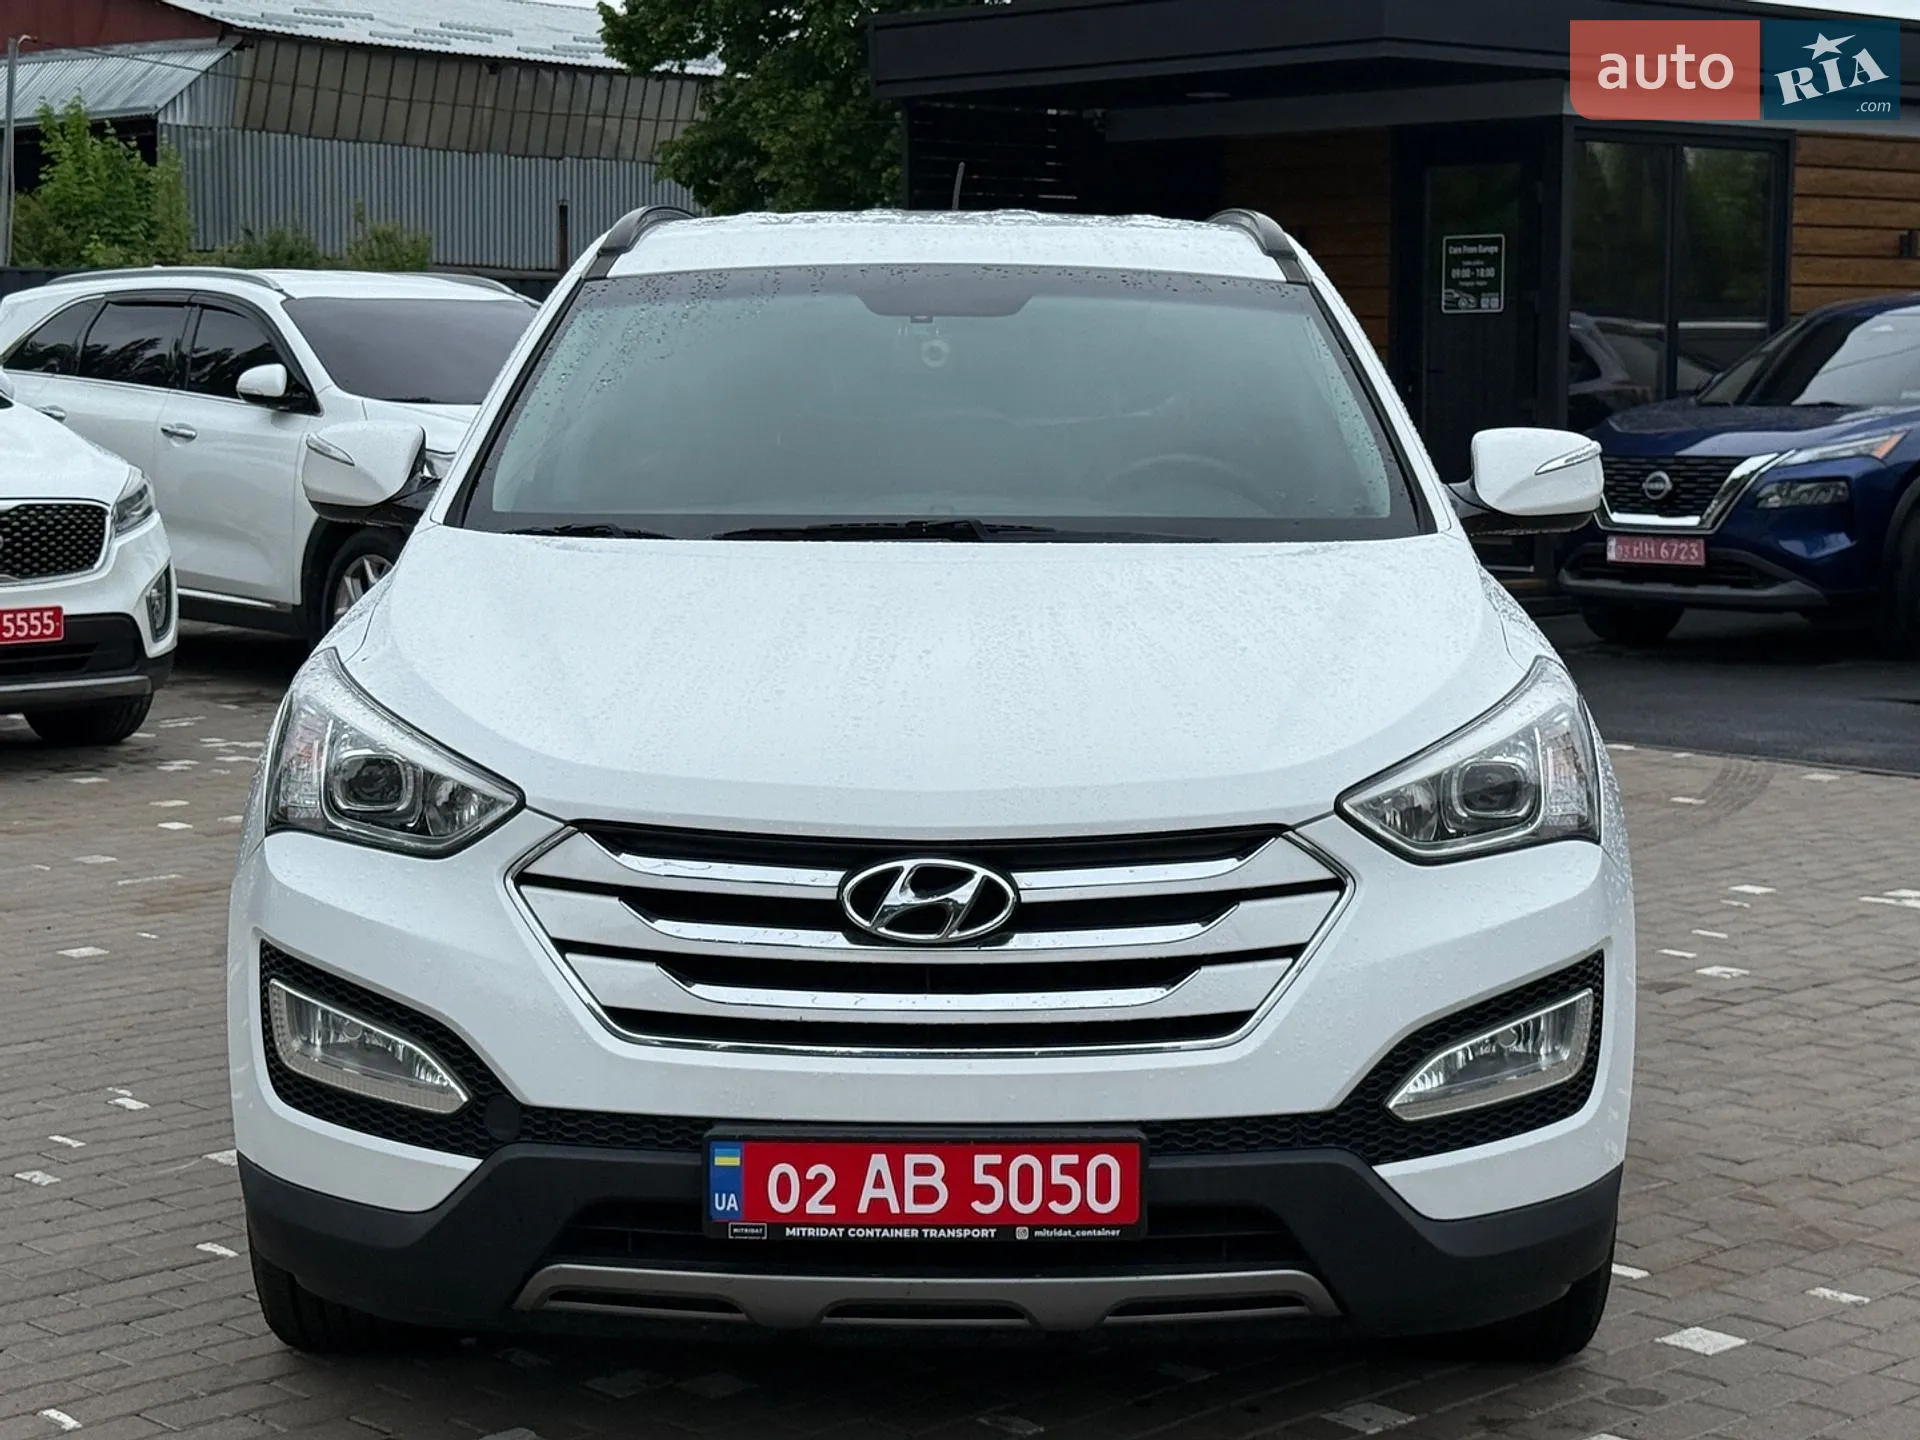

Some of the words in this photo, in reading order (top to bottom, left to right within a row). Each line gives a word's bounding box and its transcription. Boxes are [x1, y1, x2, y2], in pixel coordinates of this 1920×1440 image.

[1660, 542, 1698, 560] 6723
[2, 611, 55, 638] 5555
[768, 1163, 836, 1214] 02
[857, 1154, 949, 1214] AB
[971, 1154, 1121, 1214] 5050
[714, 1193, 739, 1211] UA
[785, 1227, 844, 1237] MITRIDAT
[848, 1228, 918, 1238] CONTAINER
[922, 1228, 997, 1238] TRANSPORT
[1034, 1227, 1121, 1238] mitridat_container
